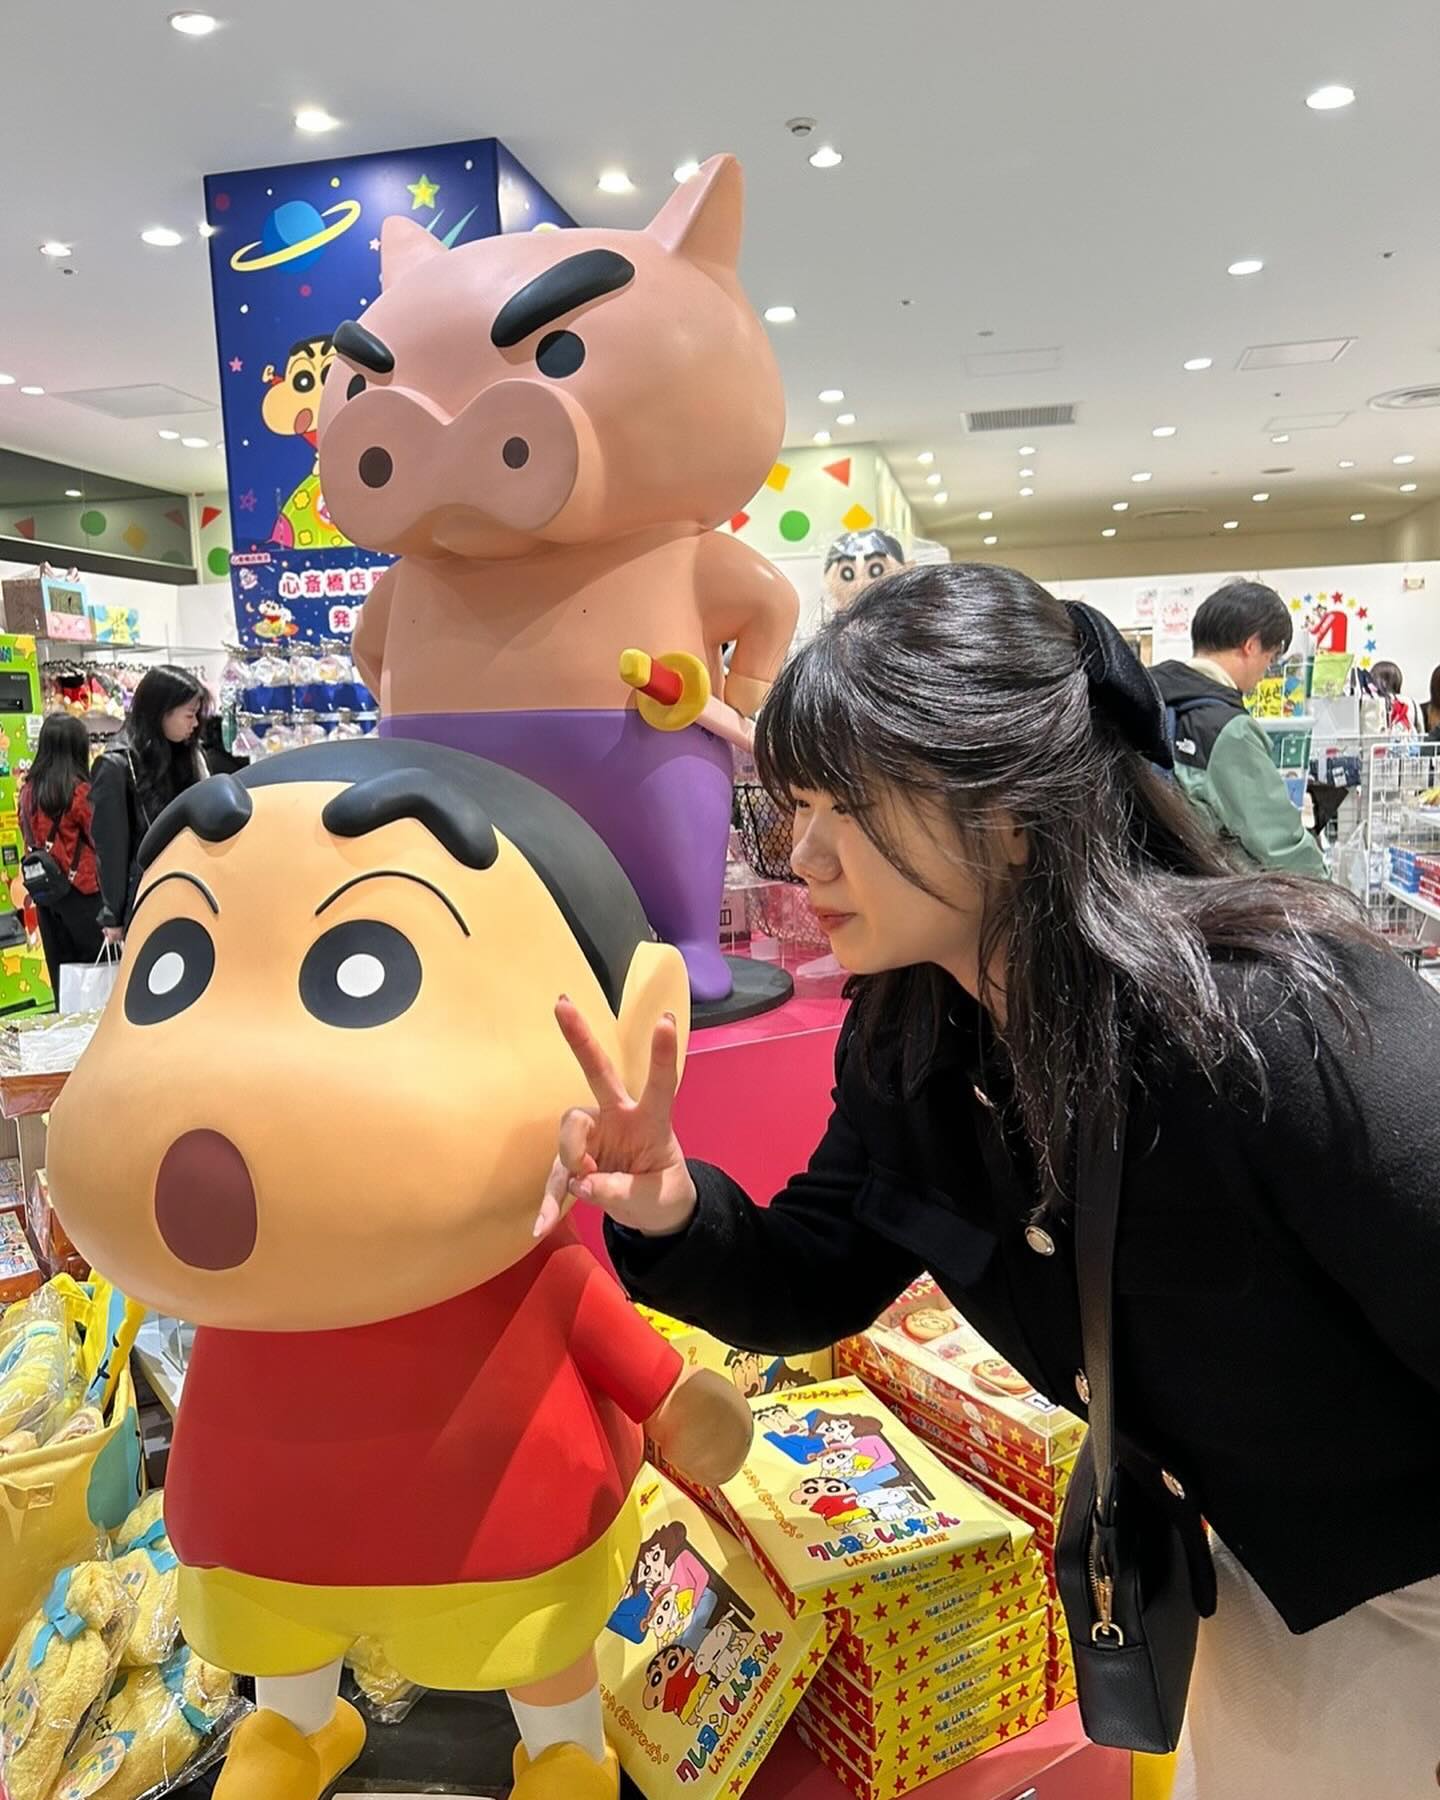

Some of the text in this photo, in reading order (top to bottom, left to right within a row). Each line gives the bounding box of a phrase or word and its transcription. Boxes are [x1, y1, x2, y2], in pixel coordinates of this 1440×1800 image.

[807, 1511, 960, 1561] クレヨンしんちゃん
[676, 1630, 783, 1783] クレヨンしんちゃん
